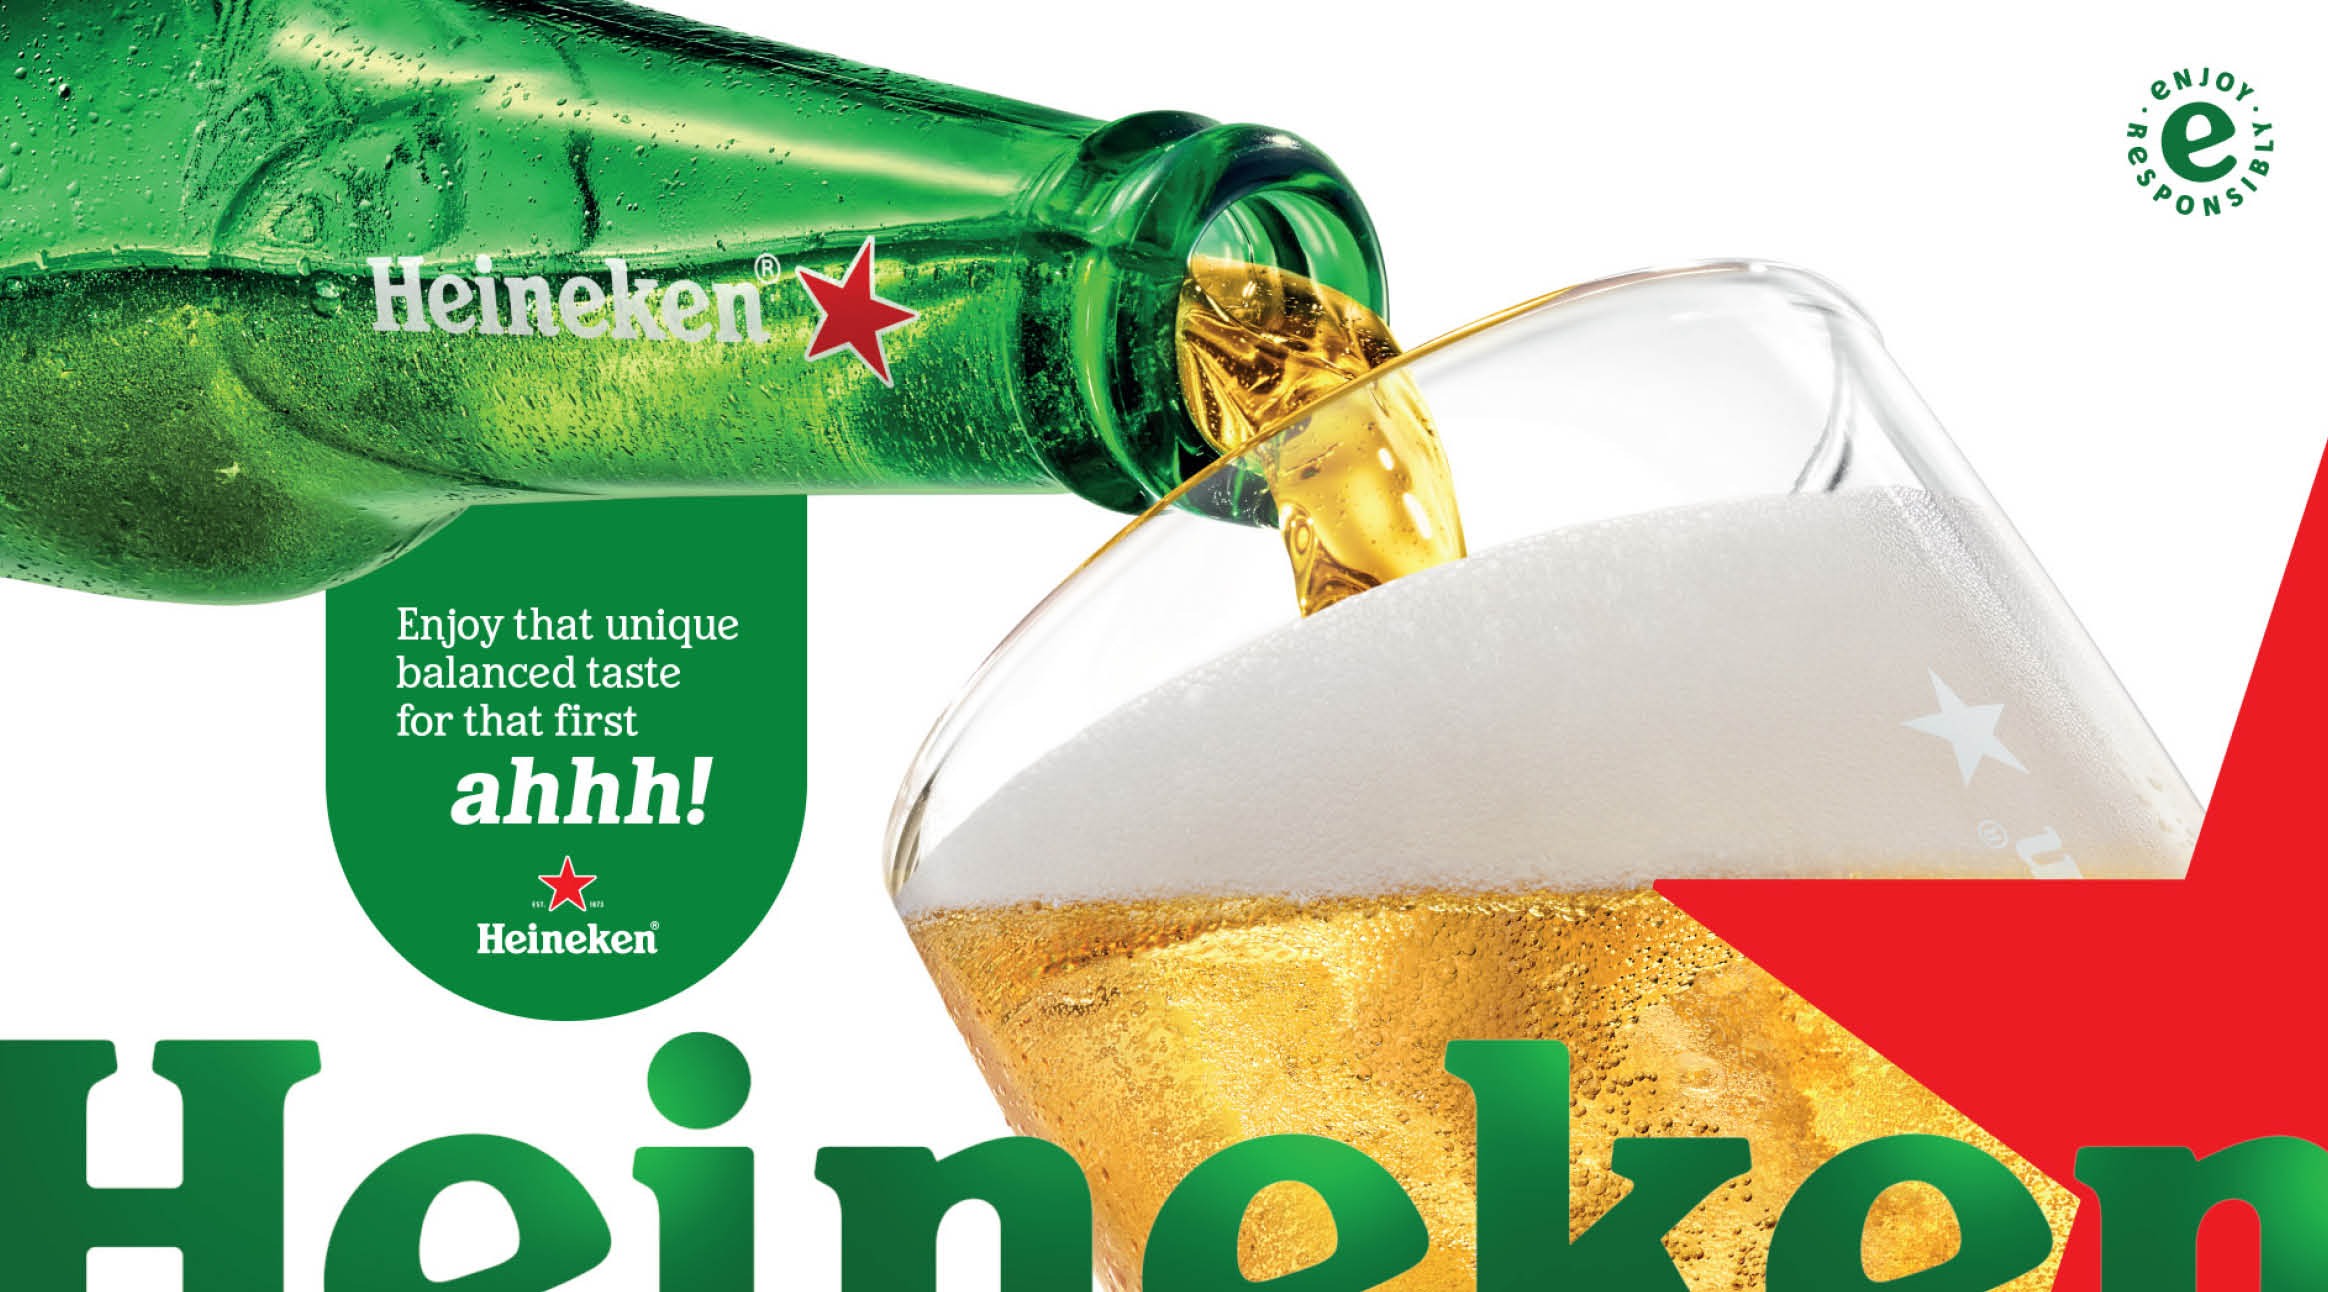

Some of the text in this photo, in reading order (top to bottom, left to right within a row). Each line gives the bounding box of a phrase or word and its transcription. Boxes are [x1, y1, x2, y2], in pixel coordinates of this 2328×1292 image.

[397, 607, 738, 648] Enjoy that unique
[396, 655, 680, 688] balanced taste
[396, 703, 638, 736] for that first
[451, 757, 713, 825] ahhh!
